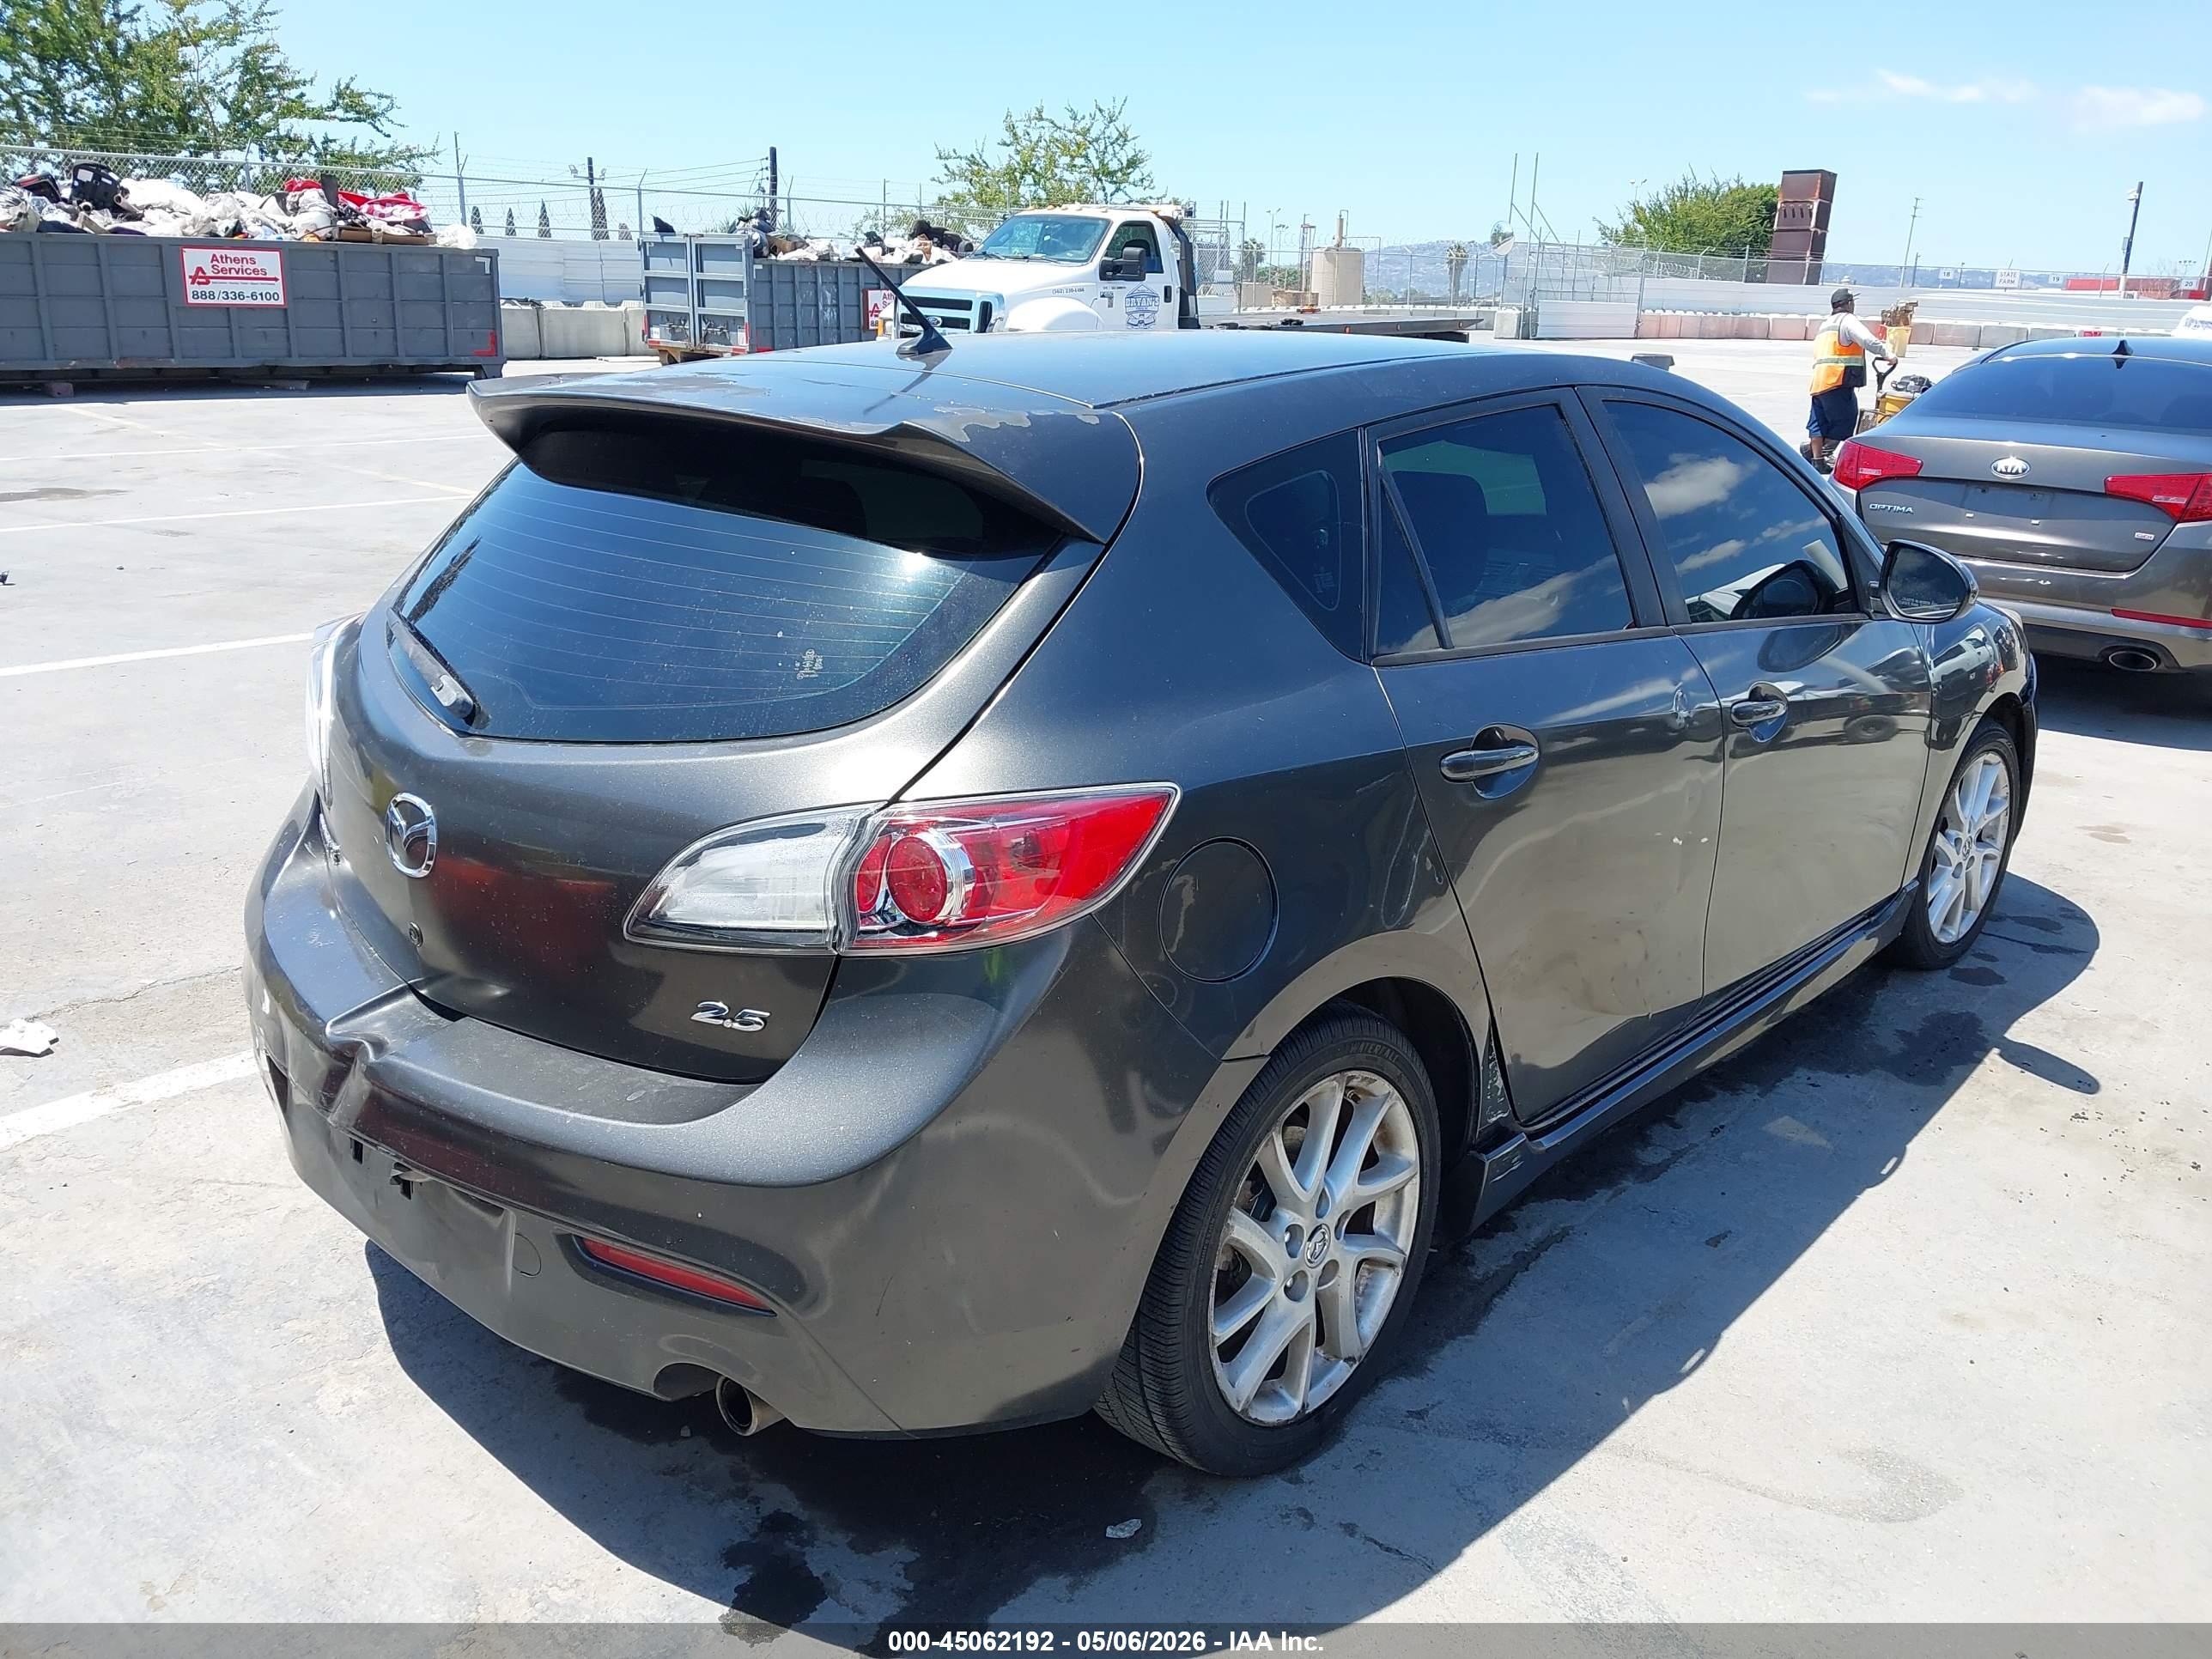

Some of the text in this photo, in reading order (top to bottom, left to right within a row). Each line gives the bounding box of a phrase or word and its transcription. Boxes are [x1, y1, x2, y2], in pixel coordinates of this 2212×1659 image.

[210, 253, 257, 264] Athens
[211, 264, 268, 276] Services
[191, 290, 280, 301] 888/336-6100
[1125, 296, 1159, 307] BRYAN'S
[1869, 502, 1914, 514] OPTIMA
[690, 1000, 771, 1032] 2.5
